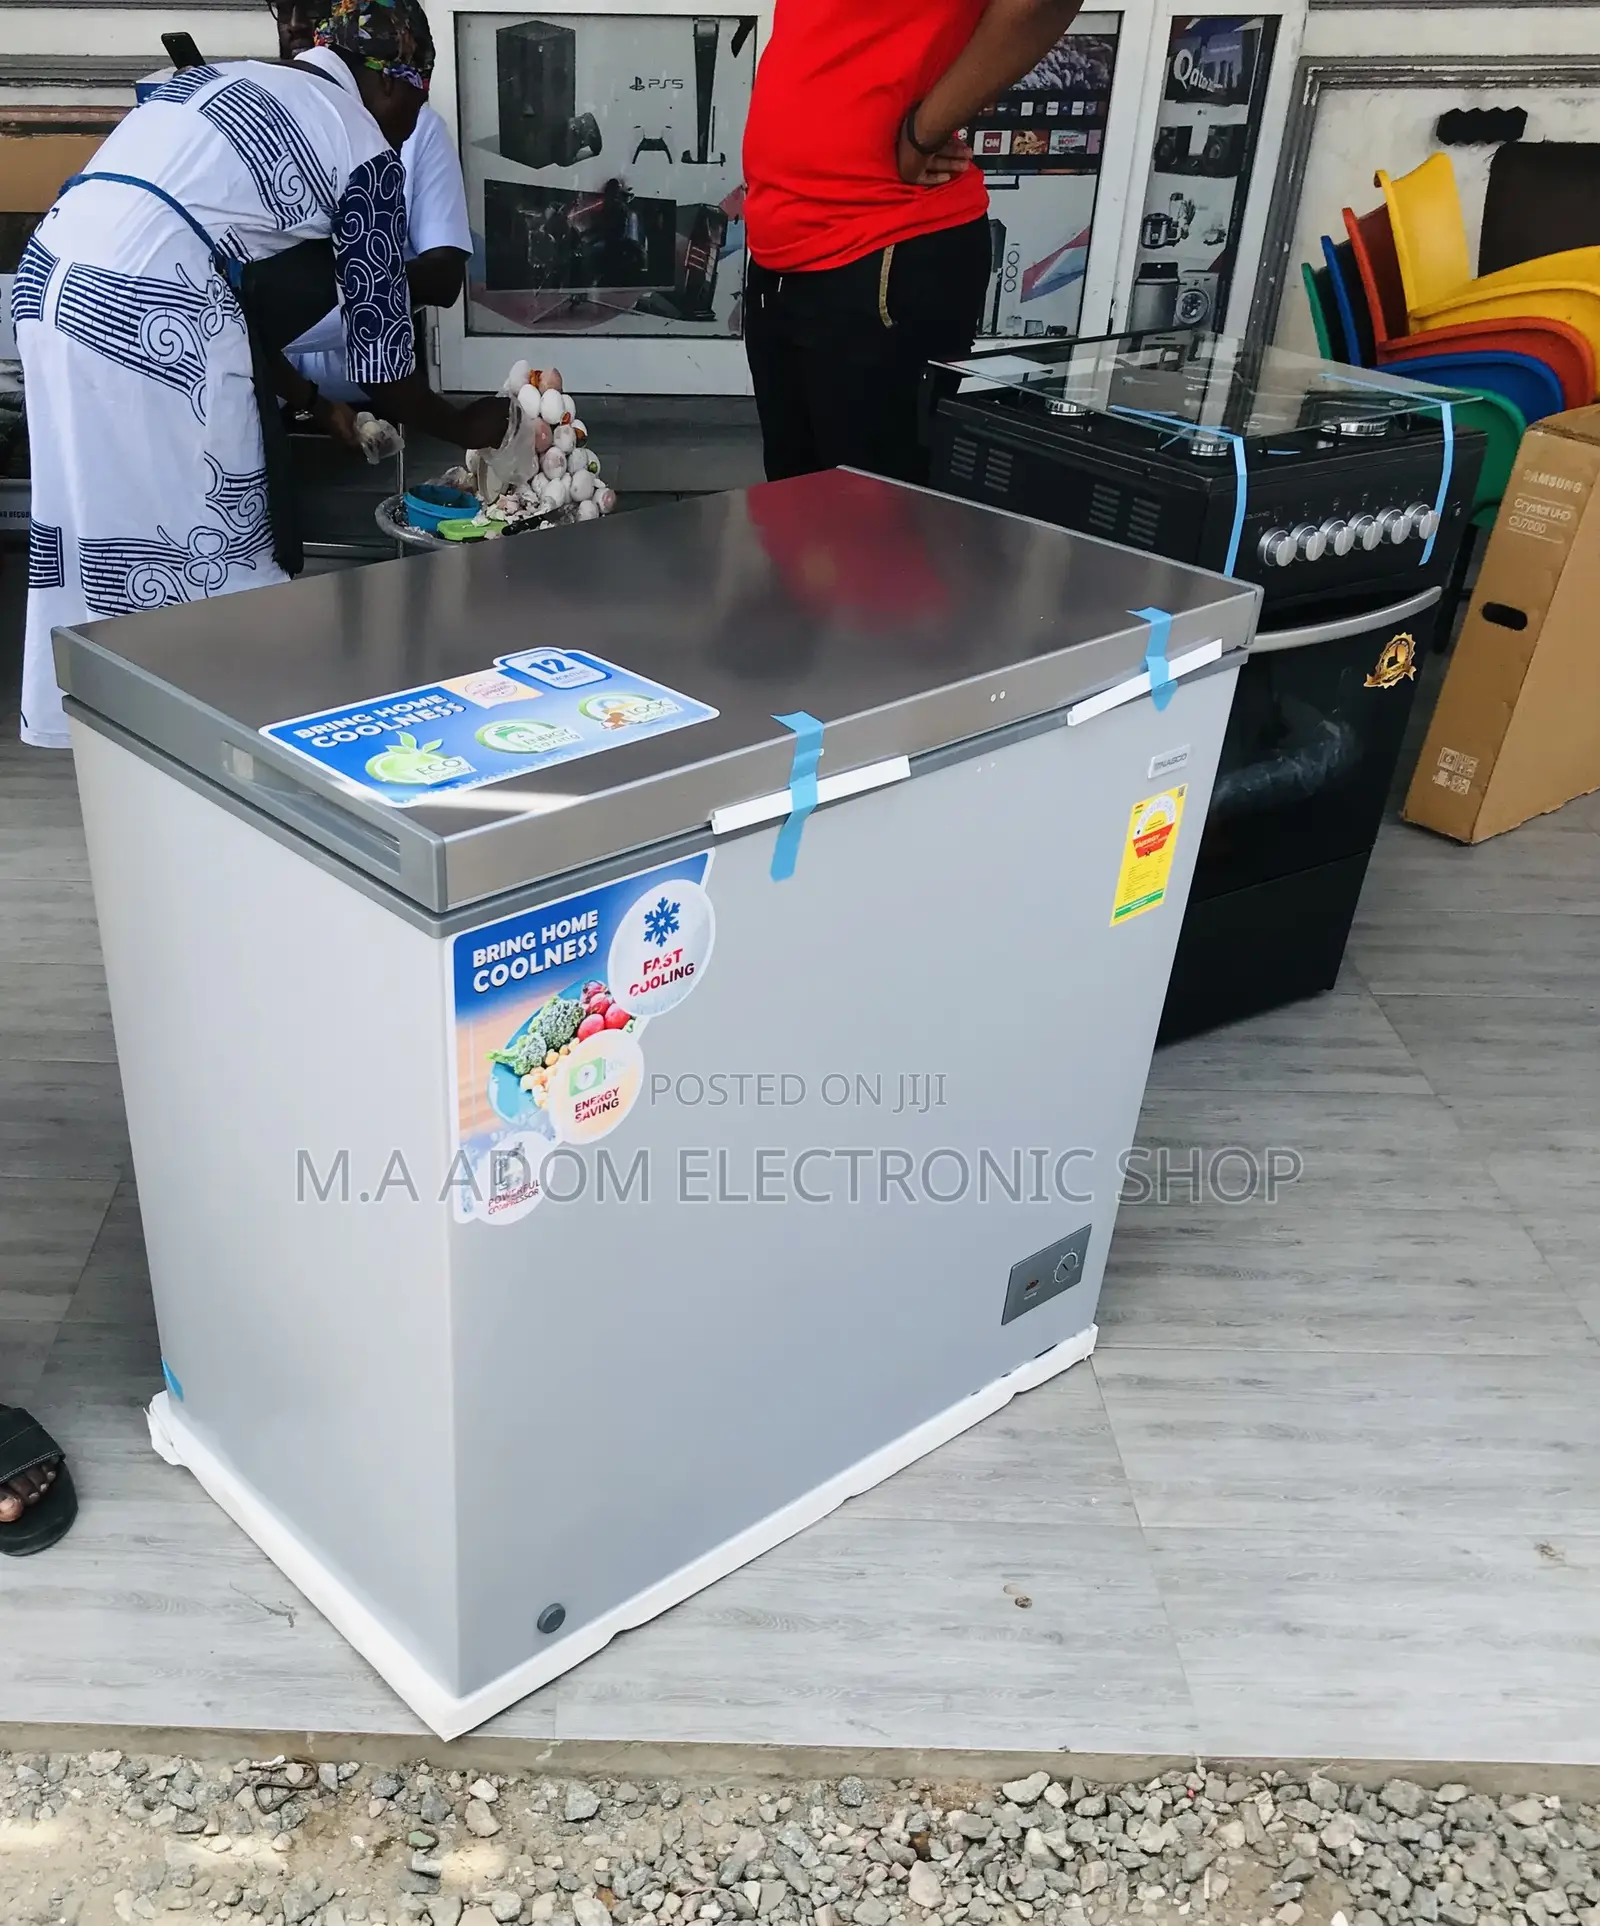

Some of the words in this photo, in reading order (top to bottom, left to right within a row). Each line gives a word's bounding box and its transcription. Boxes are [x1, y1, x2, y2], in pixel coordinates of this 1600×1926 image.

[648, 78, 684, 90] PS5
[1523, 470, 1582, 493] SAMSUNG
[1514, 498, 1551, 517] Crystal
[1550, 509, 1571, 520] UHD
[1508, 515, 1546, 533] CU7000
[527, 658, 575, 675] 12
[292, 713, 375, 740] BRING
[372, 693, 449, 719] HOME
[311, 702, 467, 748] COOLNESS
[415, 759, 462, 776] ECO
[472, 930, 536, 969] BRING
[541, 909, 600, 945] HOME
[472, 931, 598, 994] COOLNESS
[642, 948, 684, 976] FAST
[628, 963, 696, 997] COOLING
[574, 1086, 621, 1113] ENERGY
[574, 1097, 621, 1124] SAVING
